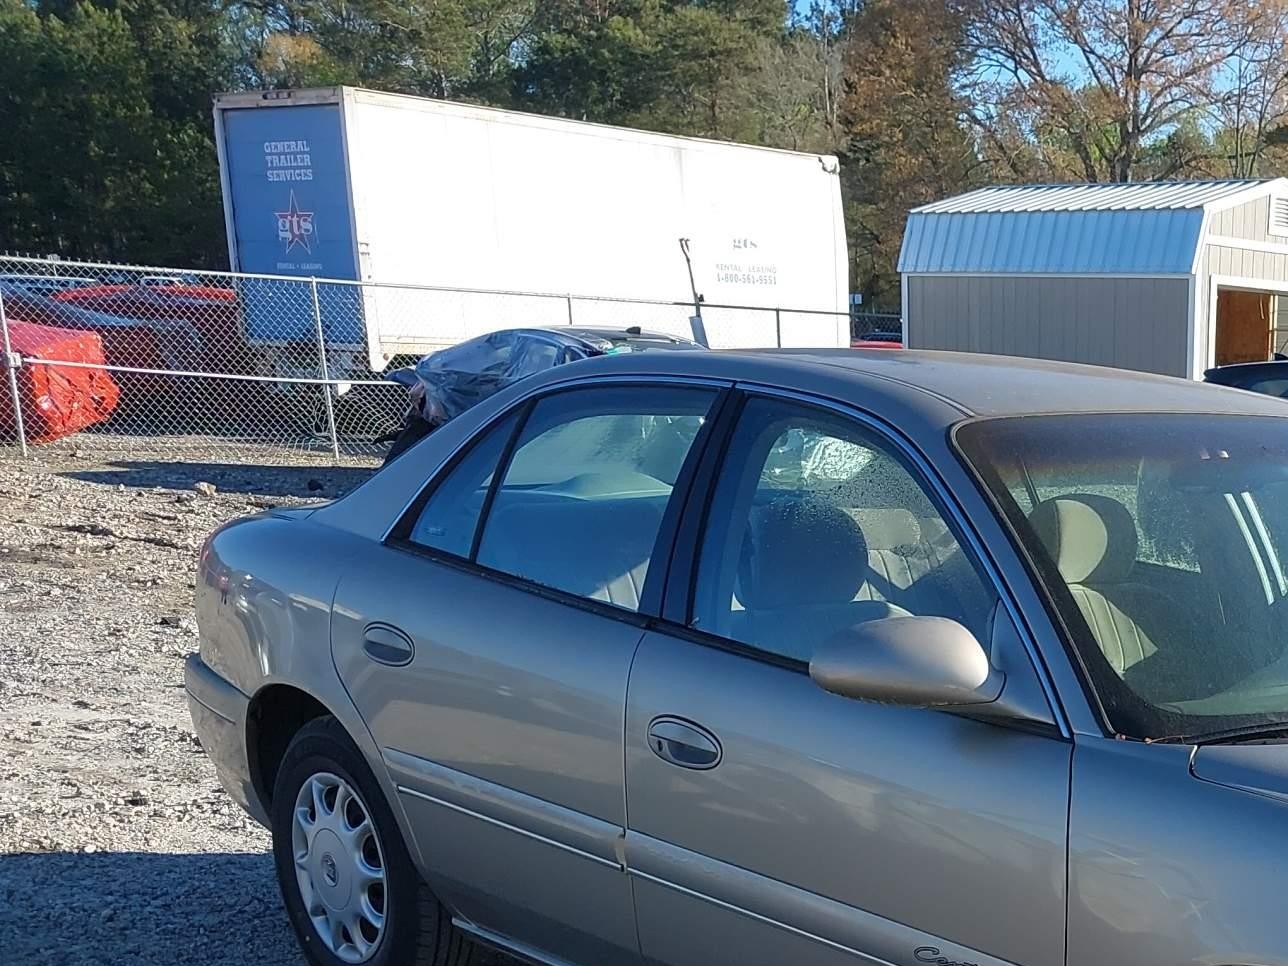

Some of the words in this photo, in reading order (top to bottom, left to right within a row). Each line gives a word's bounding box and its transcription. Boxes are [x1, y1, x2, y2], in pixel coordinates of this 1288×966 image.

[263, 140, 310, 153] GENERAL
[264, 154, 312, 167] TRAILER
[266, 168, 313, 182] SERVICES
